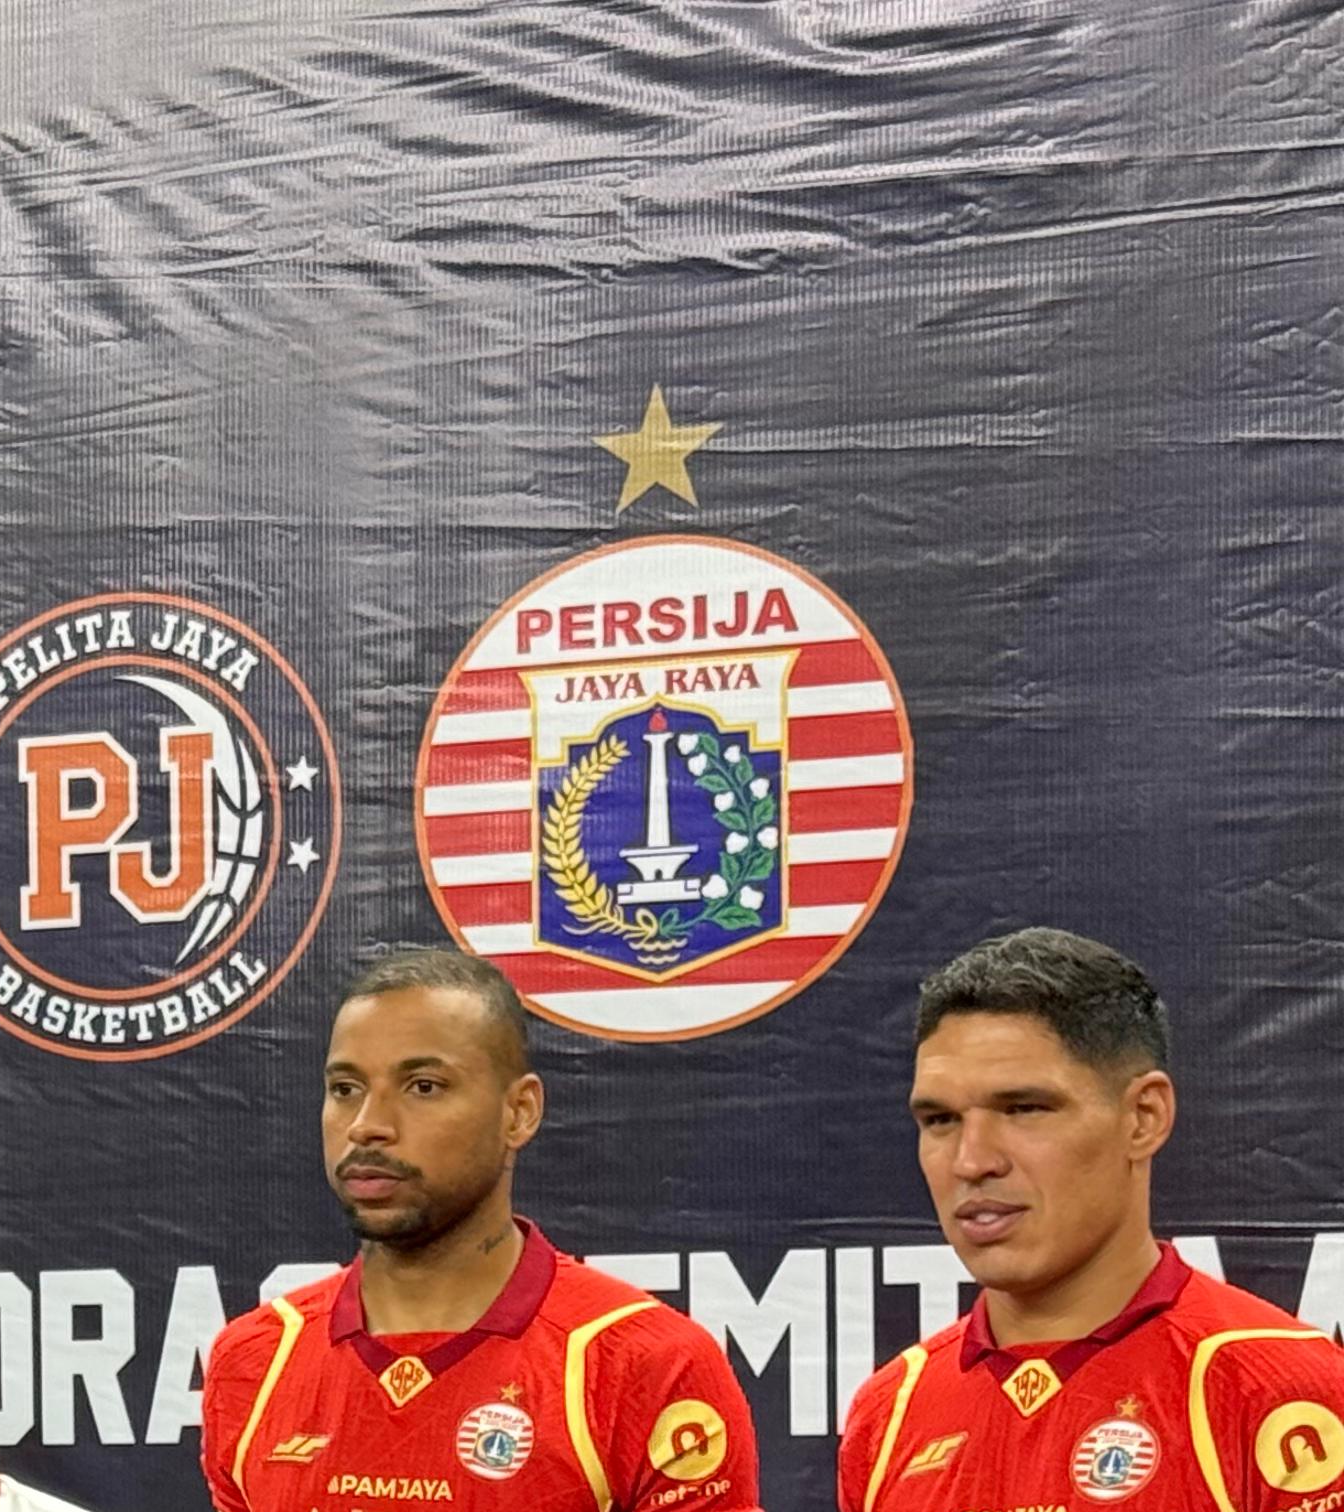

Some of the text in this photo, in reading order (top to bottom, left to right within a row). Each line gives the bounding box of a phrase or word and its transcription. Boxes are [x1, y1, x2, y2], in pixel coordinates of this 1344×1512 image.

[149, 612, 259, 691] JAYA
[516, 587, 800, 655] PERSIJA
[554, 661, 762, 704] JAYA RAYA
[19, 727, 219, 930] PJ
[340, 1474, 454, 1501] PAMJAYA
